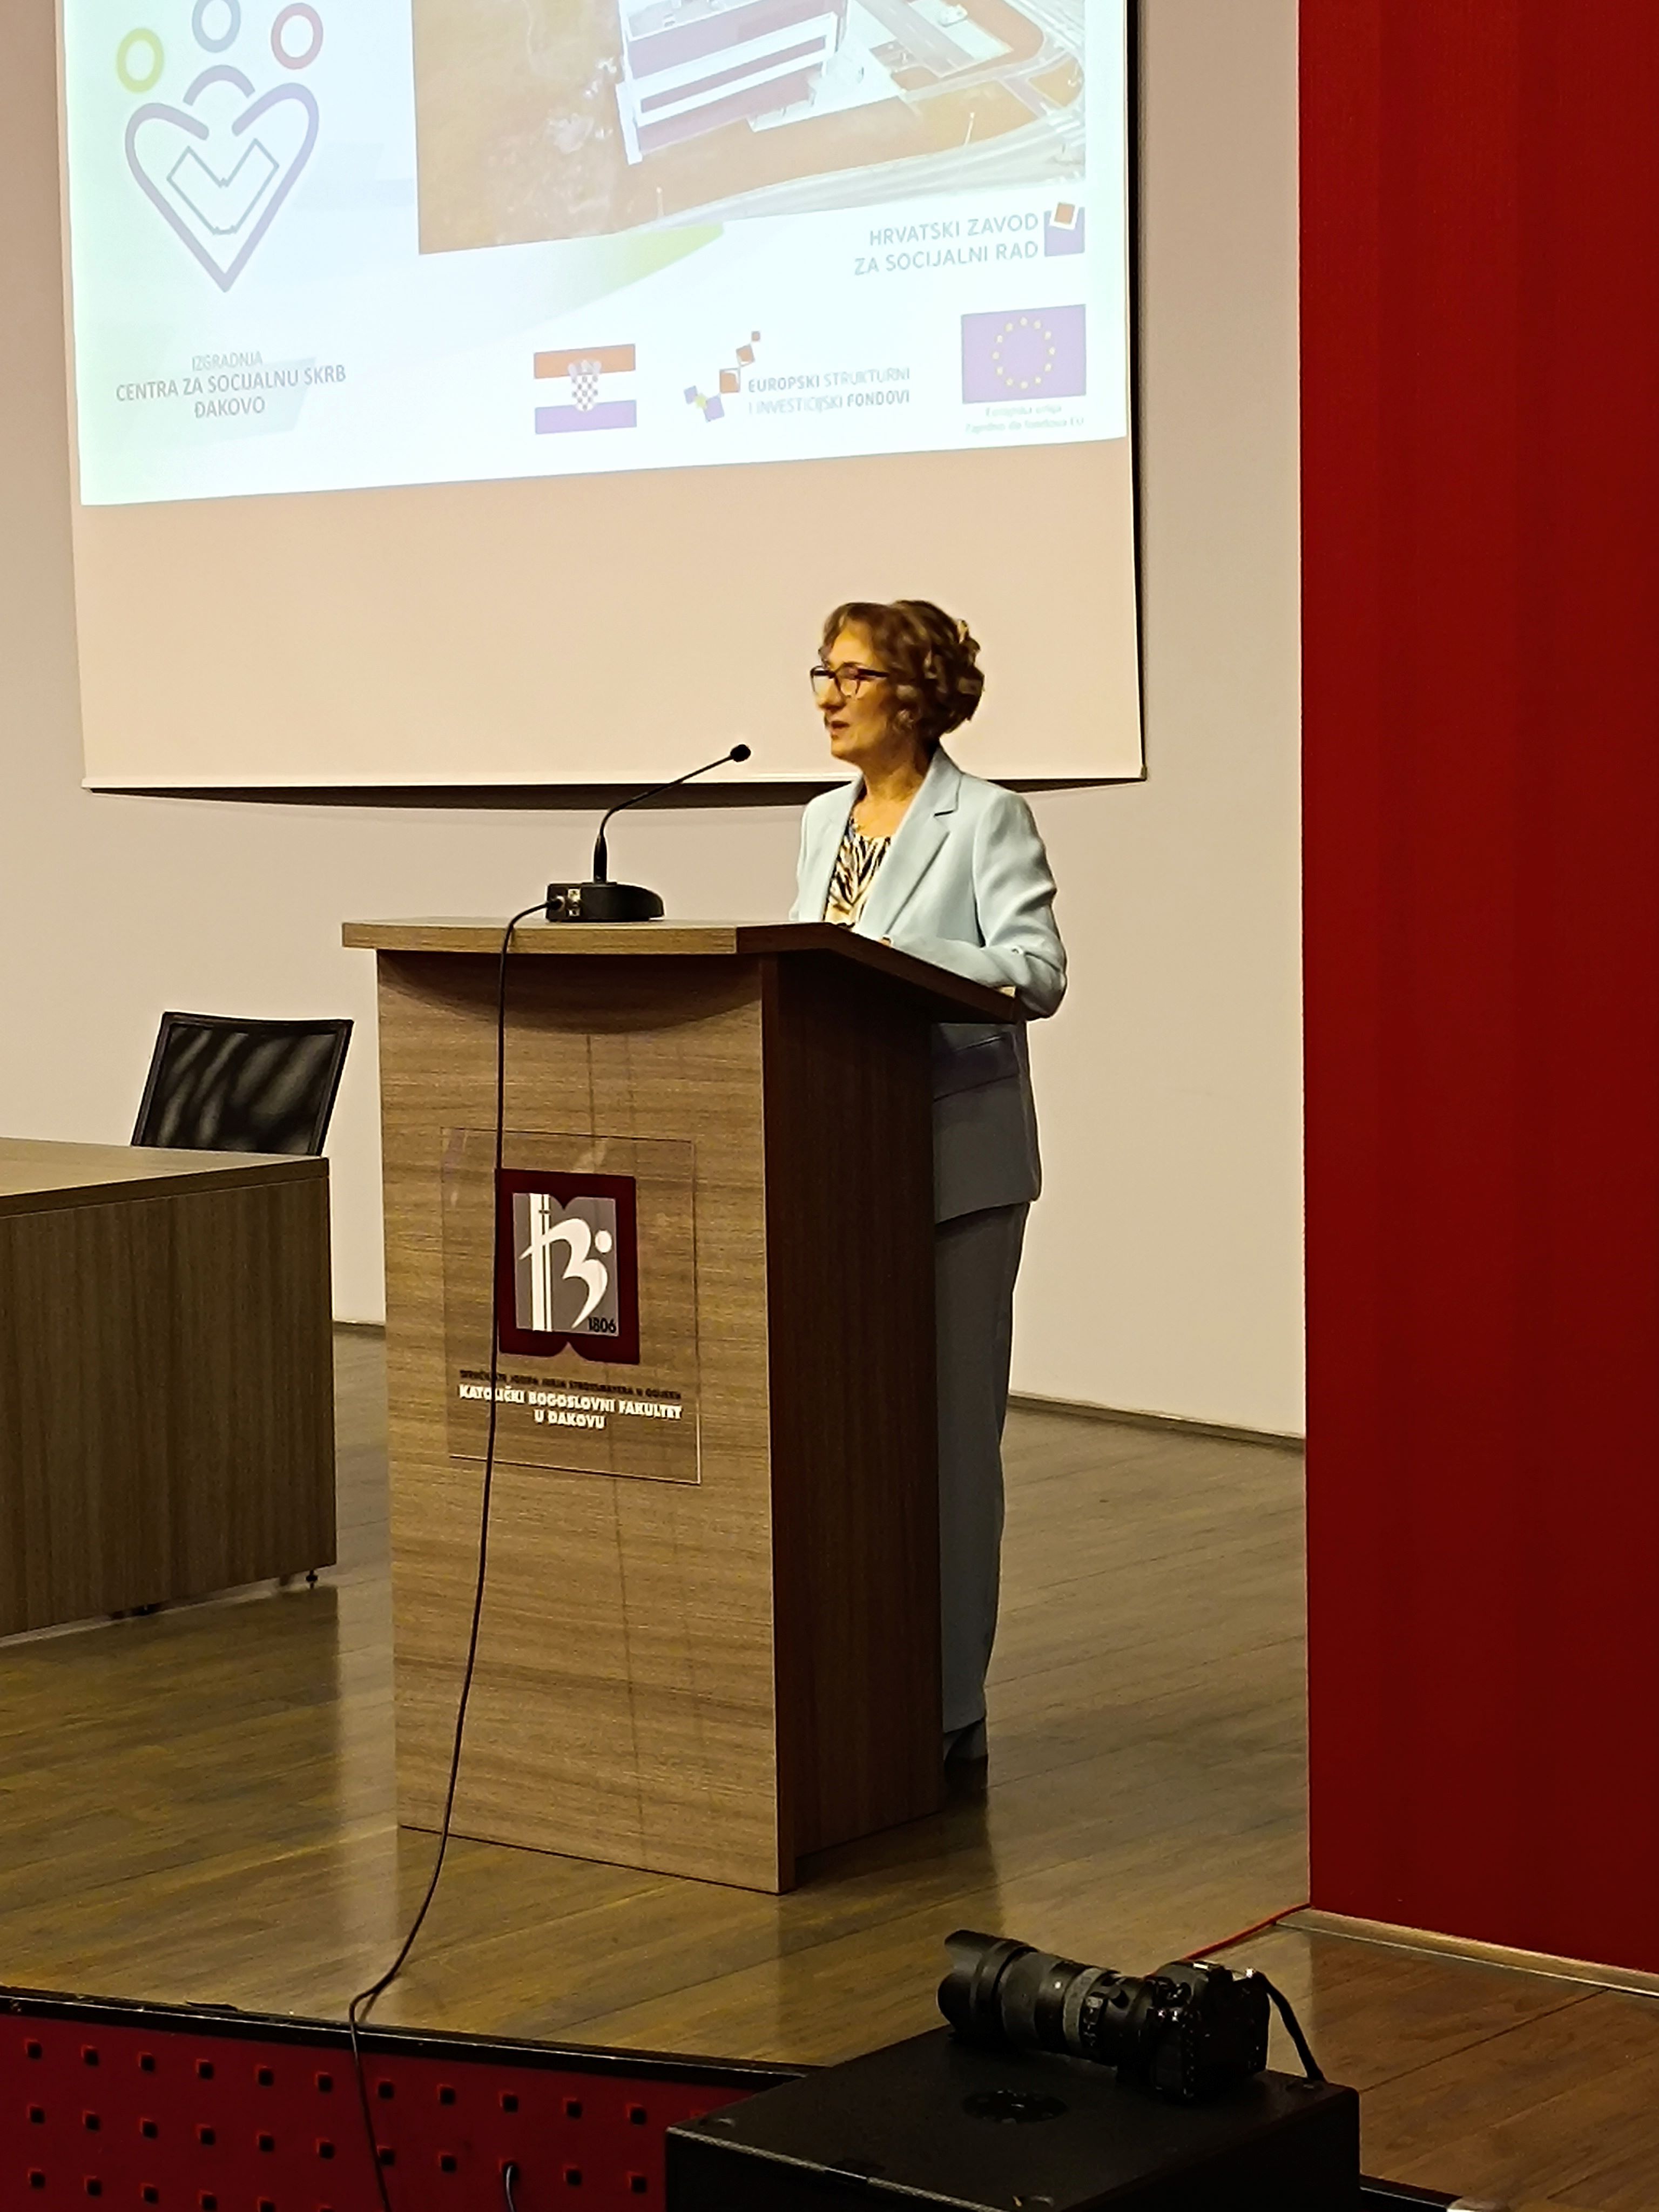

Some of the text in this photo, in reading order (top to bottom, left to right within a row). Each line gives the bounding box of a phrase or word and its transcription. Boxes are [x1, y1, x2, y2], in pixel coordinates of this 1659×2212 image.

[869, 213, 1038, 246] HRVATSKI ZAVOD
[854, 241, 1038, 275] ZA SOCIJALNI RAD
[192, 351, 263, 372] IZGRADNJA
[116, 380, 178, 402] CENTRA
[183, 377, 203, 395] ZA
[304, 365, 346, 385] SKRB
[748, 367, 910, 393] EUROPSKI STRUKTURNI
[847, 389, 910, 407] FONDOVI
[588, 1317, 617, 1333] 1806
[528, 1391, 616, 1412] BOGOSLOVNI
[618, 1400, 683, 1419] FAKULTET
[534, 1409, 544, 1423] U
